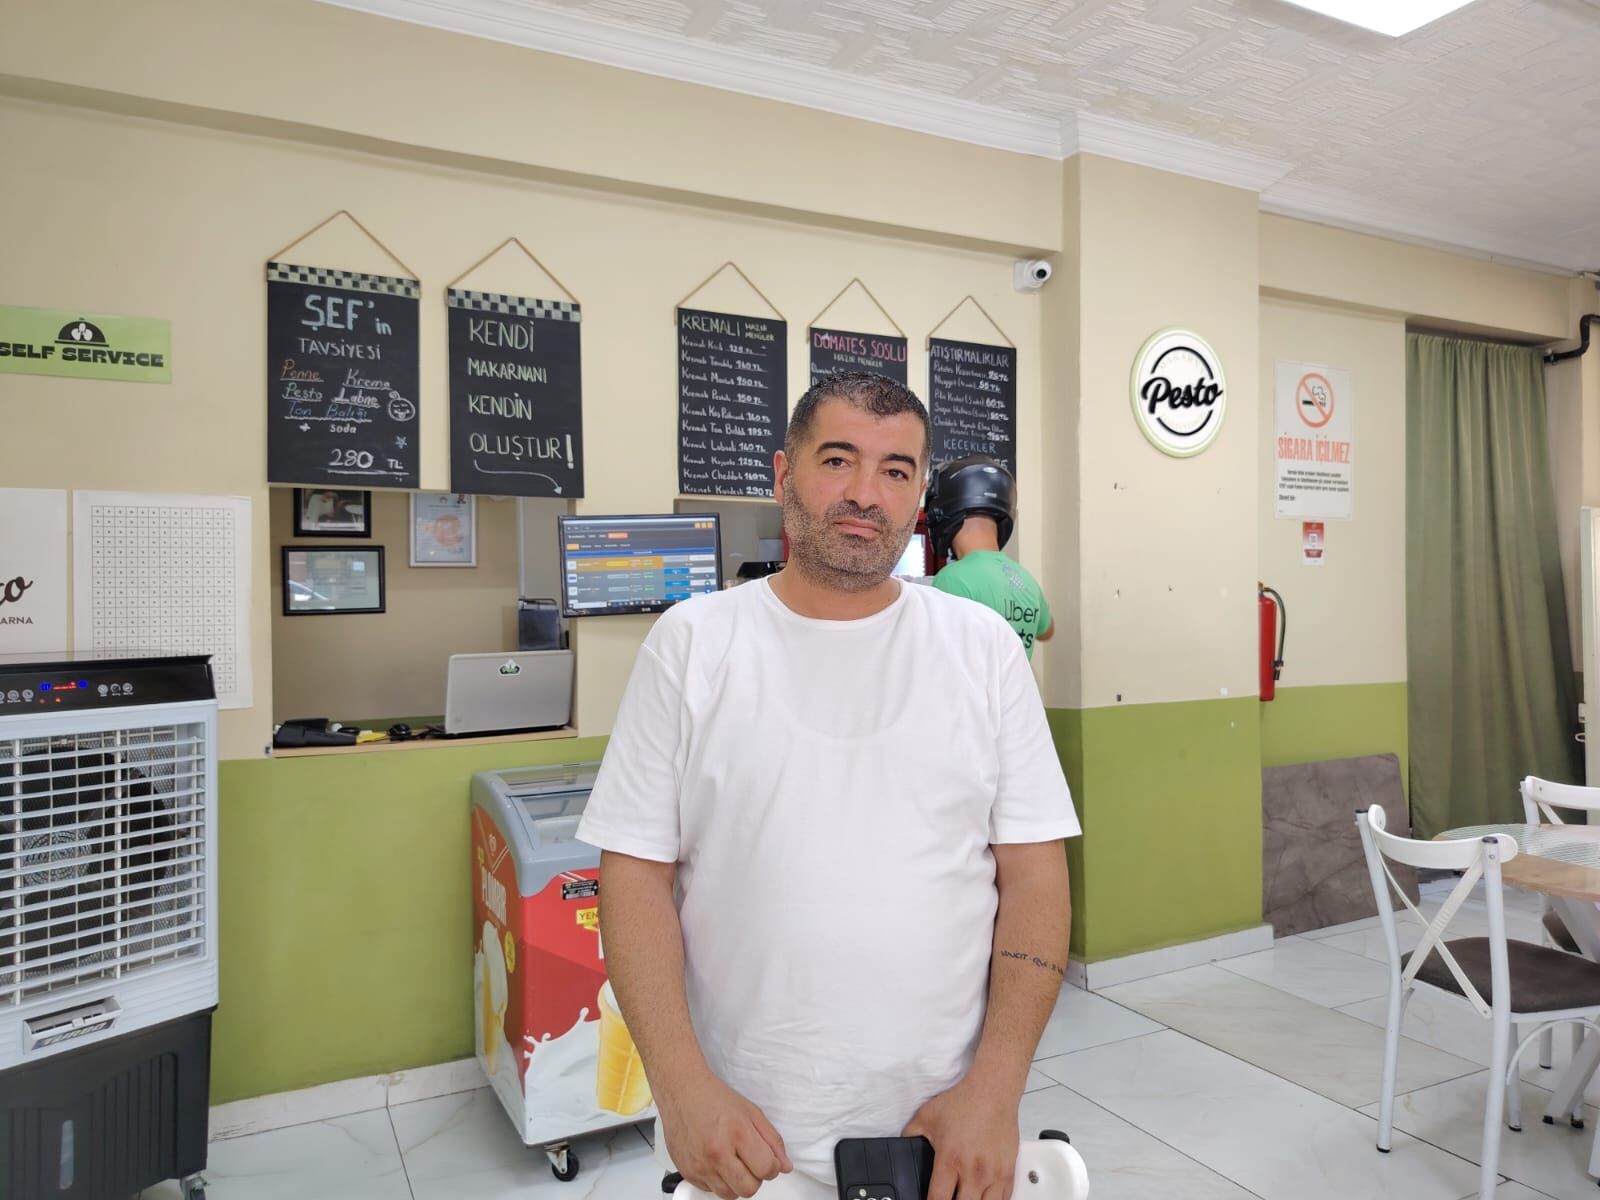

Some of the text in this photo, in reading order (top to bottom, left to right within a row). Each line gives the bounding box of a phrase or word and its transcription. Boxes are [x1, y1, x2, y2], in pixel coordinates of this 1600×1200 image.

[469, 318, 535, 352] KENDİ
[681, 313, 740, 337] KREMALI
[0, 342, 164, 367] SELF SERVICE
[298, 336, 381, 361] TAVSİYESİ
[813, 332, 906, 362] DOMATES SOSLU
[931, 345, 1009, 368] ATIŞTIRMALIKLAR
[468, 357, 548, 384] MAKARNANI
[283, 382, 323, 400] Pesto
[1141, 377, 1223, 414] Pesto
[468, 393, 532, 421] KENDİN
[329, 424, 358, 434] soda
[328, 448, 404, 470] 280 TL
[1278, 432, 1350, 466] SİGARA İÇİLMEZ
[1003, 598, 1040, 624] Uber
